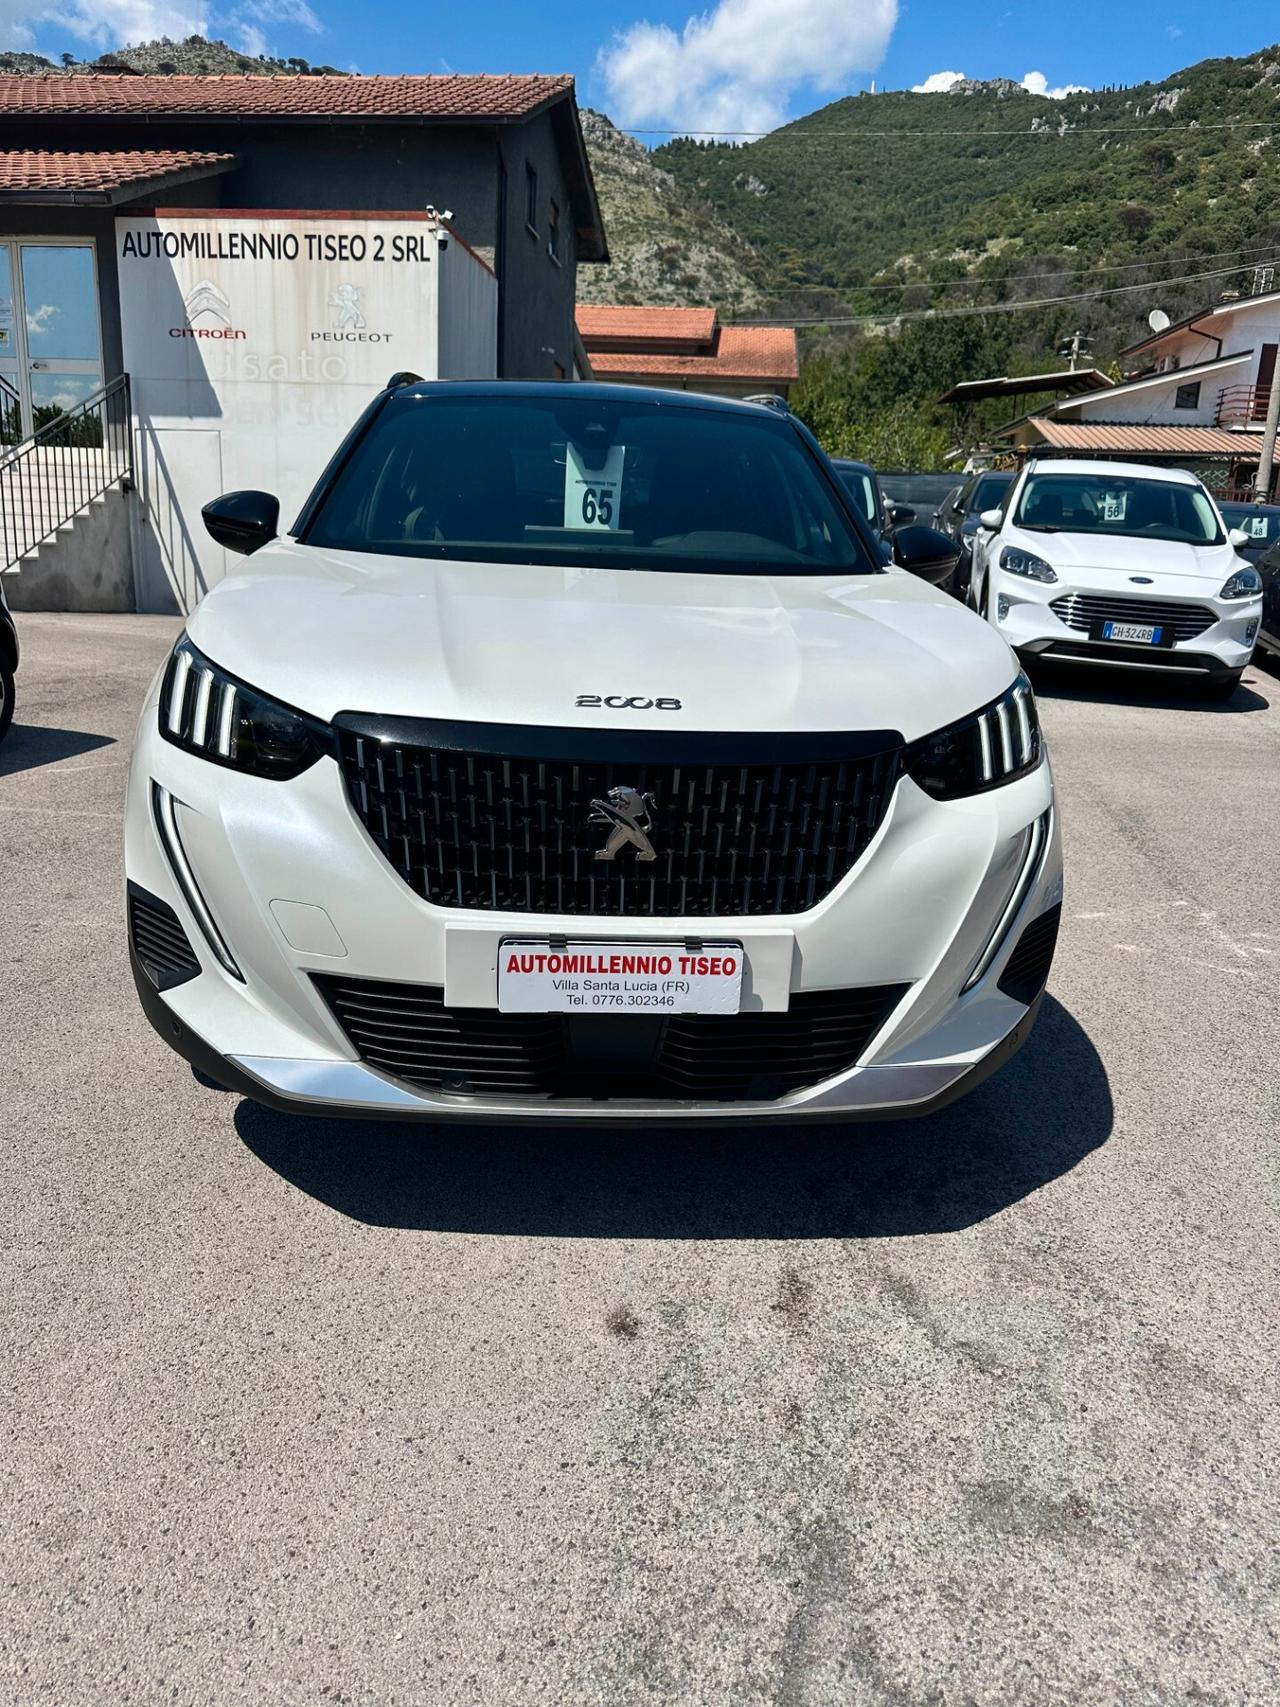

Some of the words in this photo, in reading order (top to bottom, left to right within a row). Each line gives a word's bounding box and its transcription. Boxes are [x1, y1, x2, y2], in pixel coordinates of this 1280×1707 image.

[122, 231, 299, 260] AUTOMILLENNIO
[304, 234, 366, 261] TISEO
[373, 235, 385, 261] 2
[392, 235, 430, 262] SRL
[311, 332, 392, 343] PEUGEOT
[582, 488, 613, 525] 65
[1107, 506, 1119, 518] 56
[575, 695, 682, 710] 2008
[506, 954, 672, 974] AUTOMILLENNIO
[678, 956, 737, 975] TISEO
[552, 980, 578, 991] Villa
[583, 980, 619, 991] Santa
[624, 981, 657, 992] Lucia
[662, 981, 690, 994] (FR)
[567, 994, 588, 1006] Tel.
[592, 995, 675, 1006] 0776.302346
